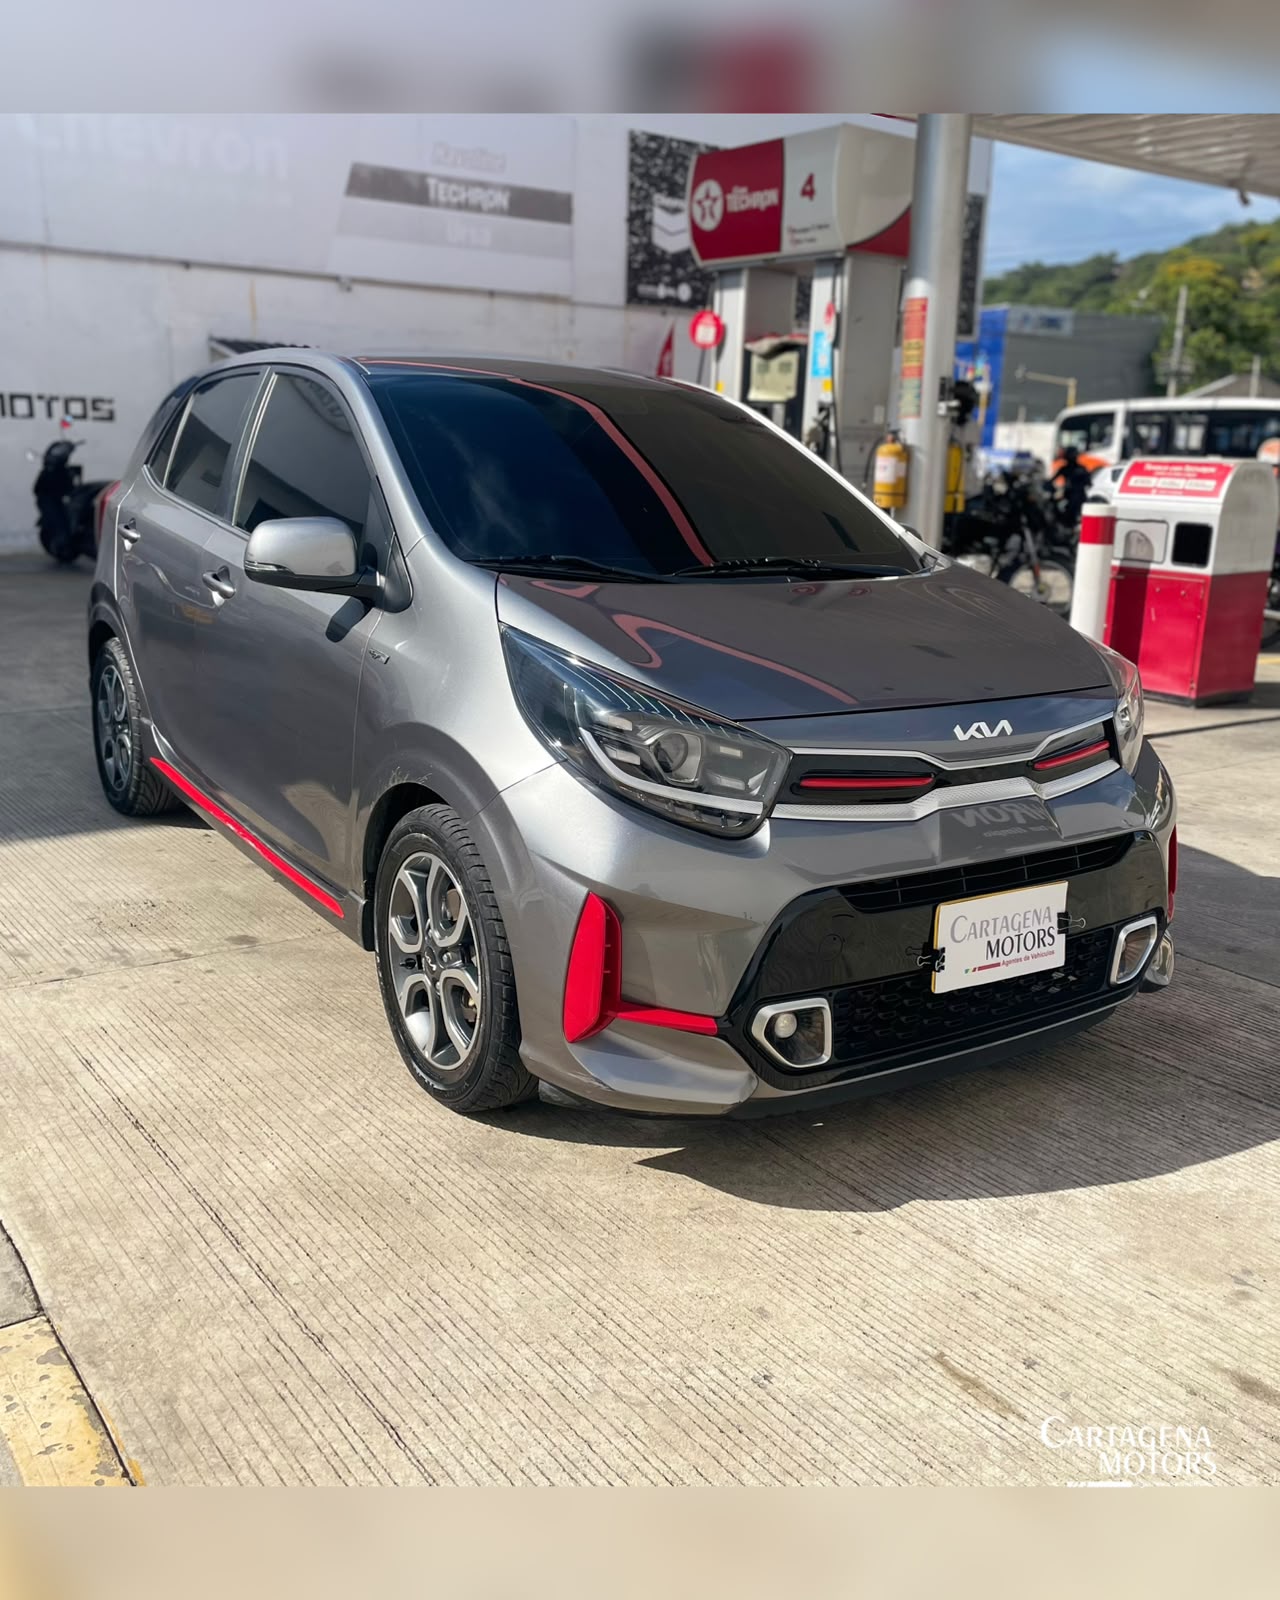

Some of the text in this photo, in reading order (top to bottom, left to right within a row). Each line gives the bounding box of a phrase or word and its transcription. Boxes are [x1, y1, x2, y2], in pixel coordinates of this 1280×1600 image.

[426, 174, 511, 213] TECHRON
[800, 172, 815, 202] 4
[953, 719, 1013, 741] KIA
[950, 906, 1052, 943] CARTAGENA
[985, 926, 1056, 960] MOTORS
[1001, 957, 1022, 967] Agentes
[1023, 954, 1030, 962] de
